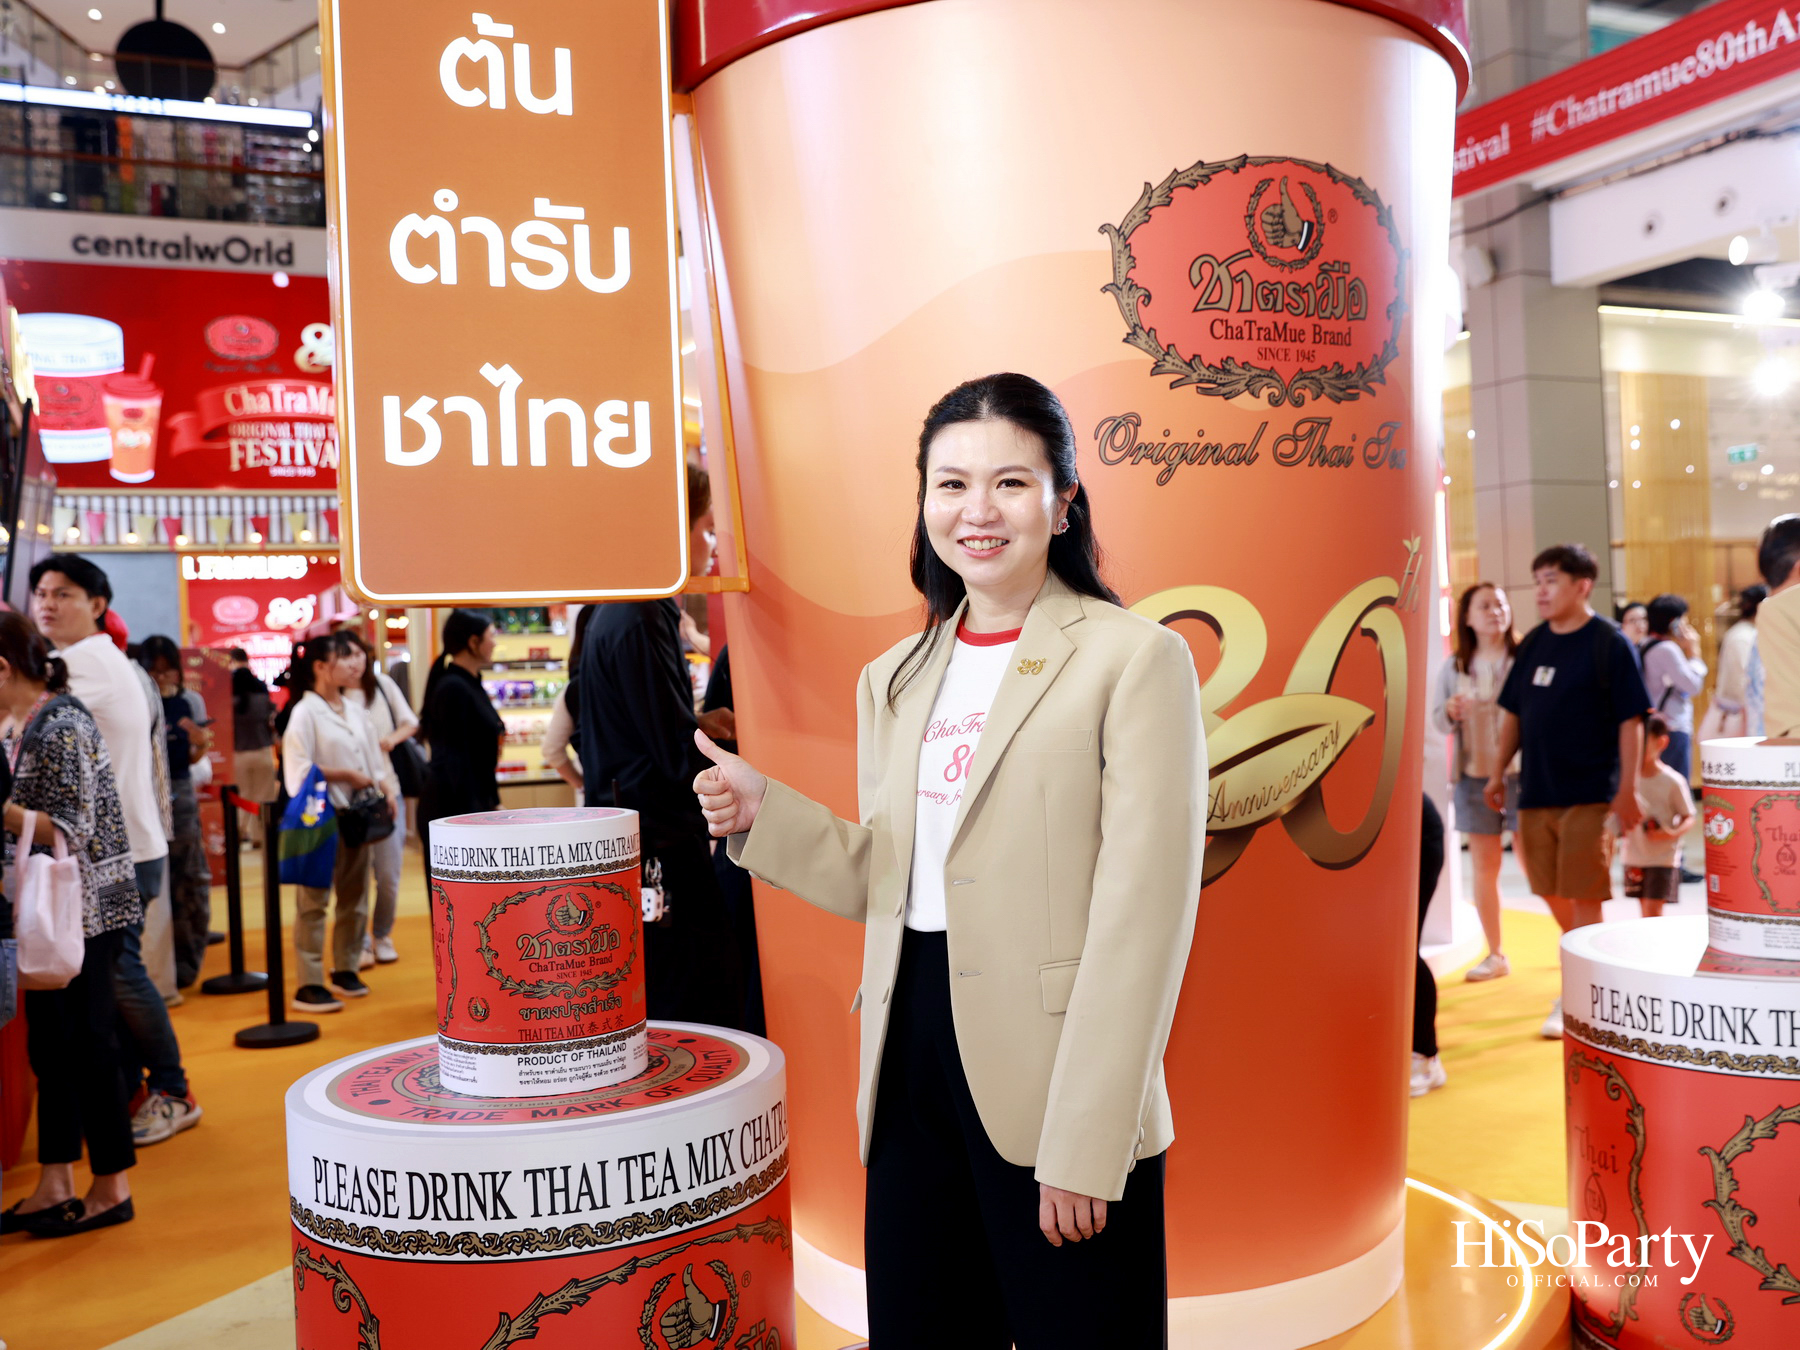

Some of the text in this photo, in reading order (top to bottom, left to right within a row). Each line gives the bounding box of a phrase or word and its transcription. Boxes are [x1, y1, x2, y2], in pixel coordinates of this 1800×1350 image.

[440, 13, 573, 116] ต้น
[389, 188, 631, 294] ตำรับ
[1189, 249, 1368, 321] ชาตรามือ
[1209, 318, 1352, 346] ChaTraMue Brand
[1257, 347, 1316, 363] SINCE 1945
[382, 362, 653, 468] ชาไทย
[1094, 412, 1268, 487] Original
[1272, 416, 1356, 468] Thai
[1206, 720, 1341, 823] Anniversary
[433, 844, 459, 866] PLEASE
[461, 845, 499, 867] DRINK
[501, 846, 535, 867] THAI
[537, 844, 566, 866] TEA
[568, 841, 592, 864] MIX
[516, 924, 621, 961] ชาตรามือ
[528, 955, 613, 973] ChaTraMue Brand
[556, 968, 593, 980] SINCE 1945
[519, 991, 623, 1022] ชาผงปรุงสำเร็จ
[1589, 983, 1663, 1034] PLEASE
[1671, 1000, 1761, 1046] DRINK
[517, 1053, 568, 1066] PRODUCT
[570, 1051, 584, 1062] OF
[586, 1042, 627, 1059] THAILAND
[518, 1028, 543, 1042] THAI
[544, 1025, 564, 1040] TEA
[566, 1023, 586, 1039] MIX
[399, 1106, 509, 1121] TRADE
[531, 1098, 635, 1119] MARK
[644, 1085, 684, 1098] OF
[685, 1049, 732, 1082] QUALITY
[312, 1155, 400, 1220] PLEASE
[407, 1170, 518, 1222] DRINK
[524, 1158, 611, 1219] THAI
[617, 1146, 680, 1205] TEA
[686, 1128, 738, 1191] MIX
